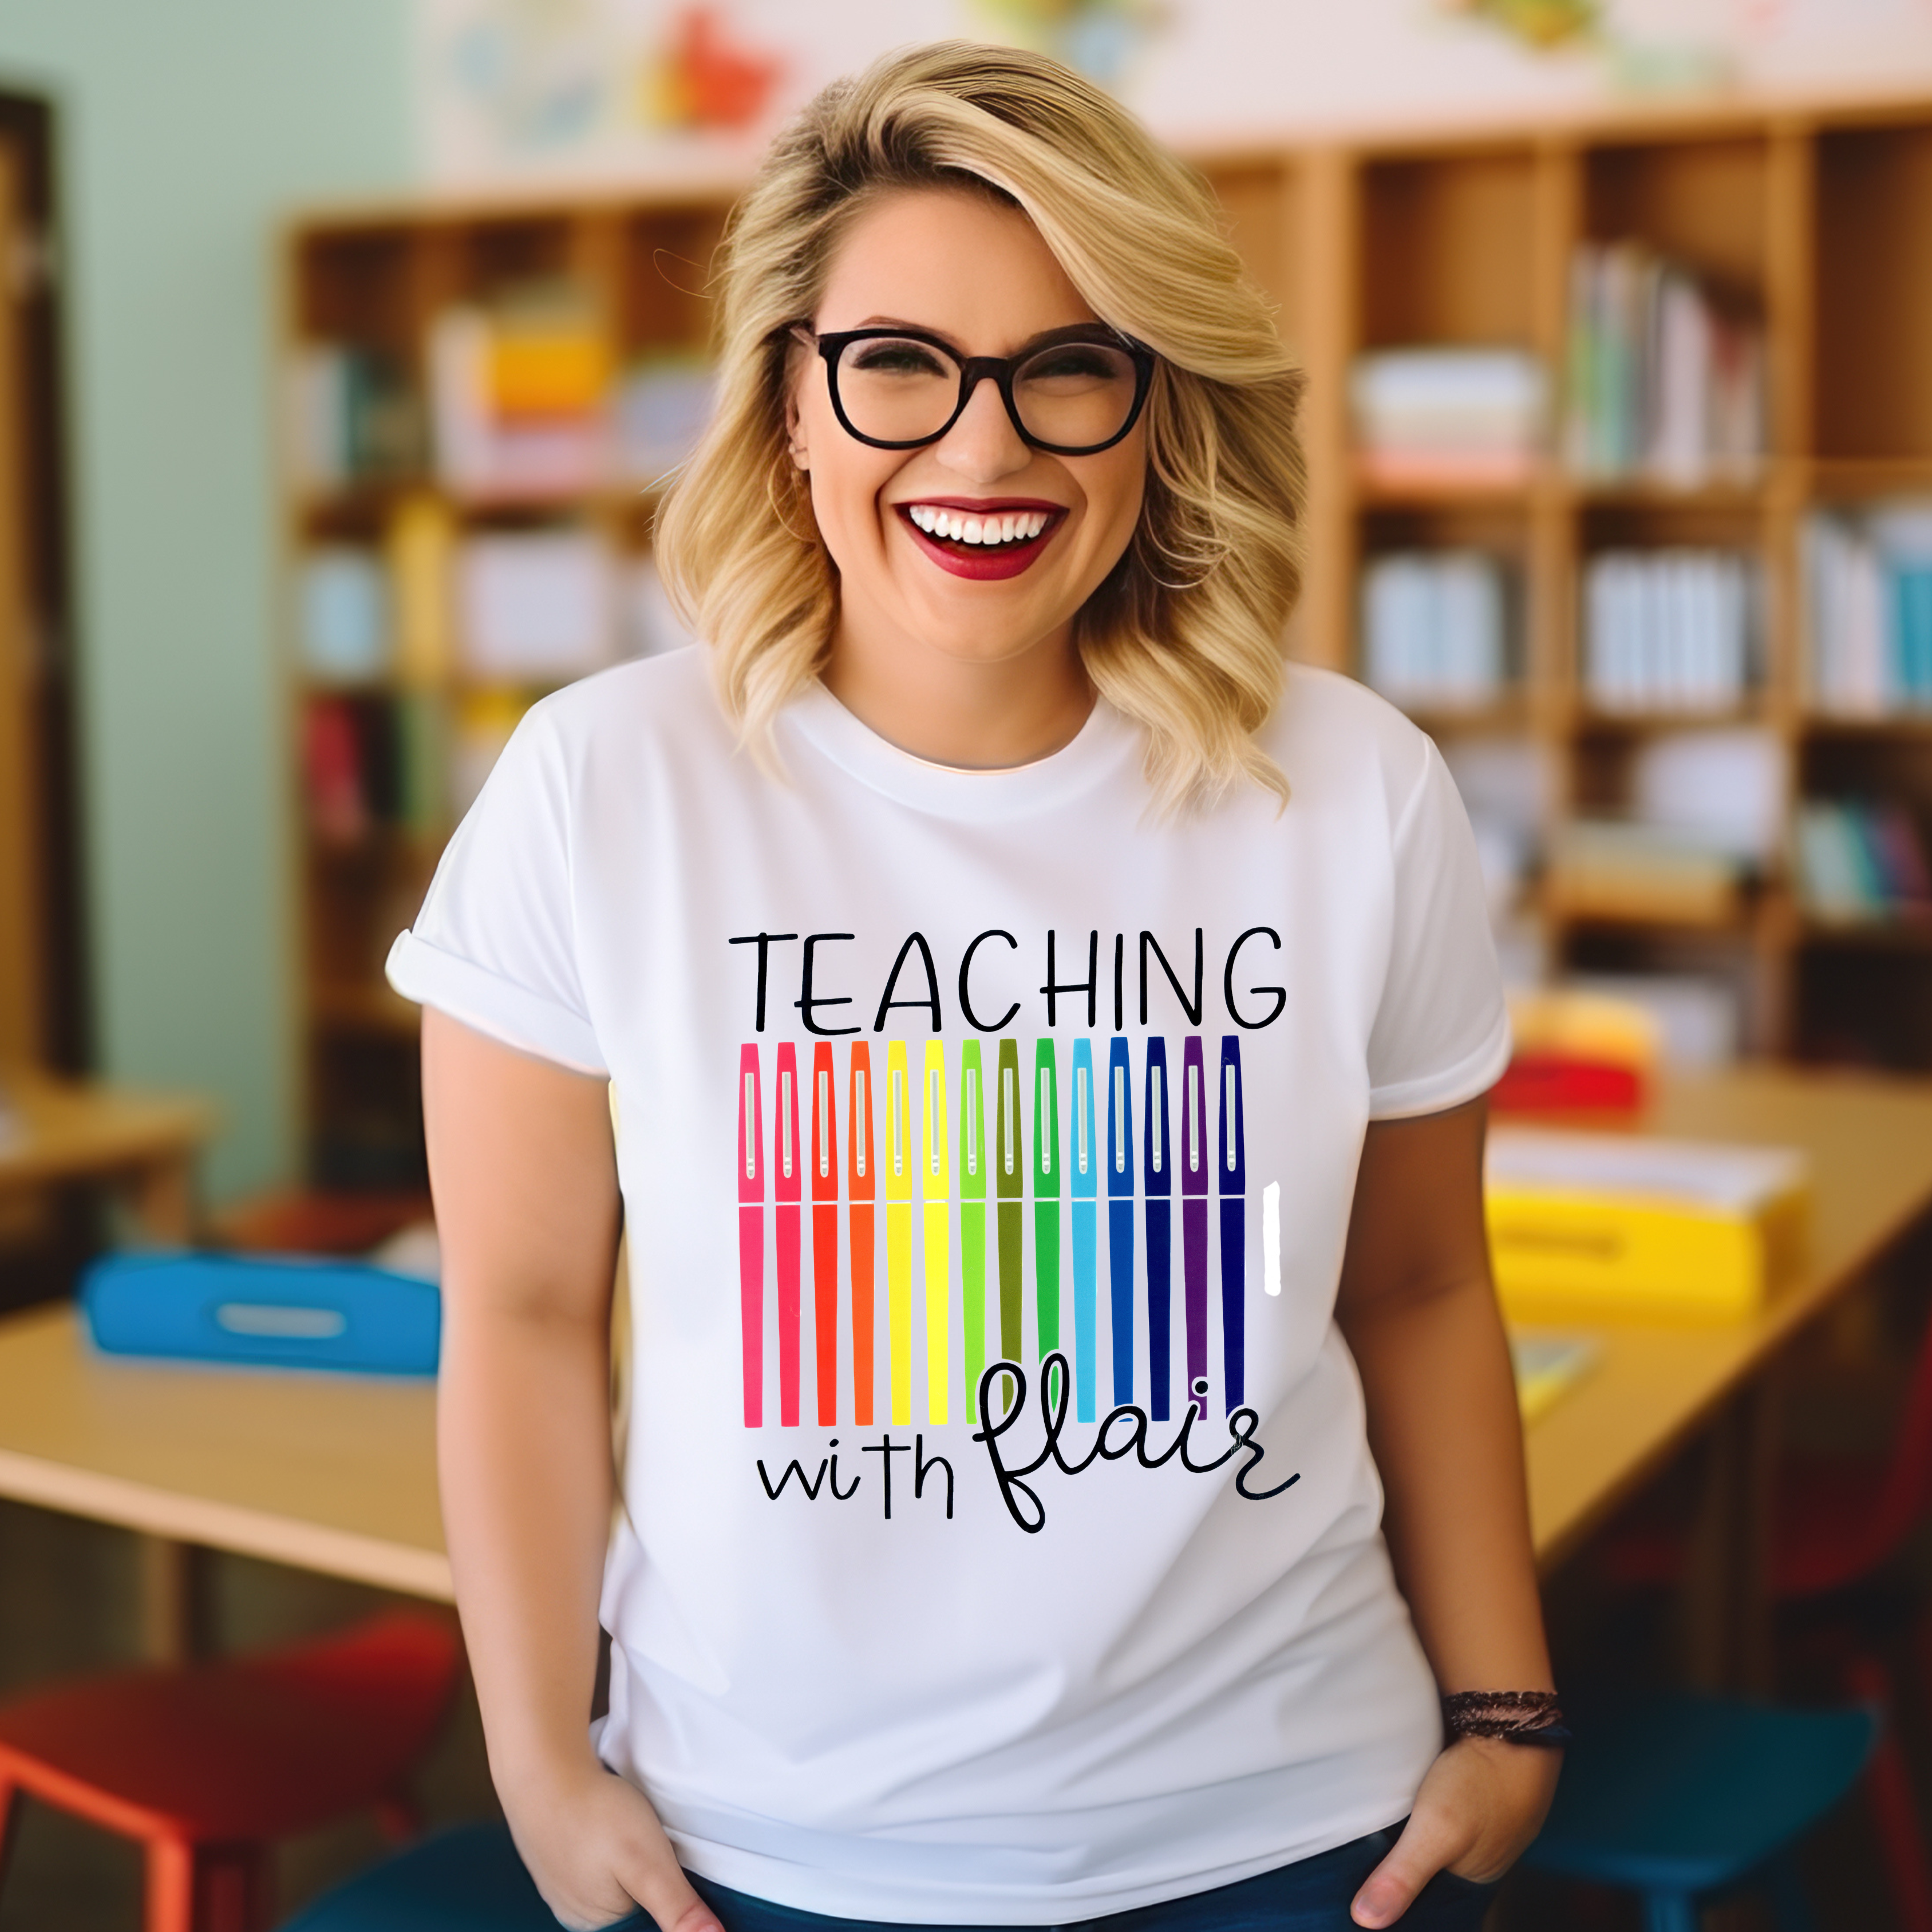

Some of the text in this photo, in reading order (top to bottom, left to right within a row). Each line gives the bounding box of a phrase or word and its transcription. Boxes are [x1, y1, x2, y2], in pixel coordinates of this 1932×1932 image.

[728, 926, 1287, 1036] TEACHING
[756, 1352, 1302, 1535] with flair
